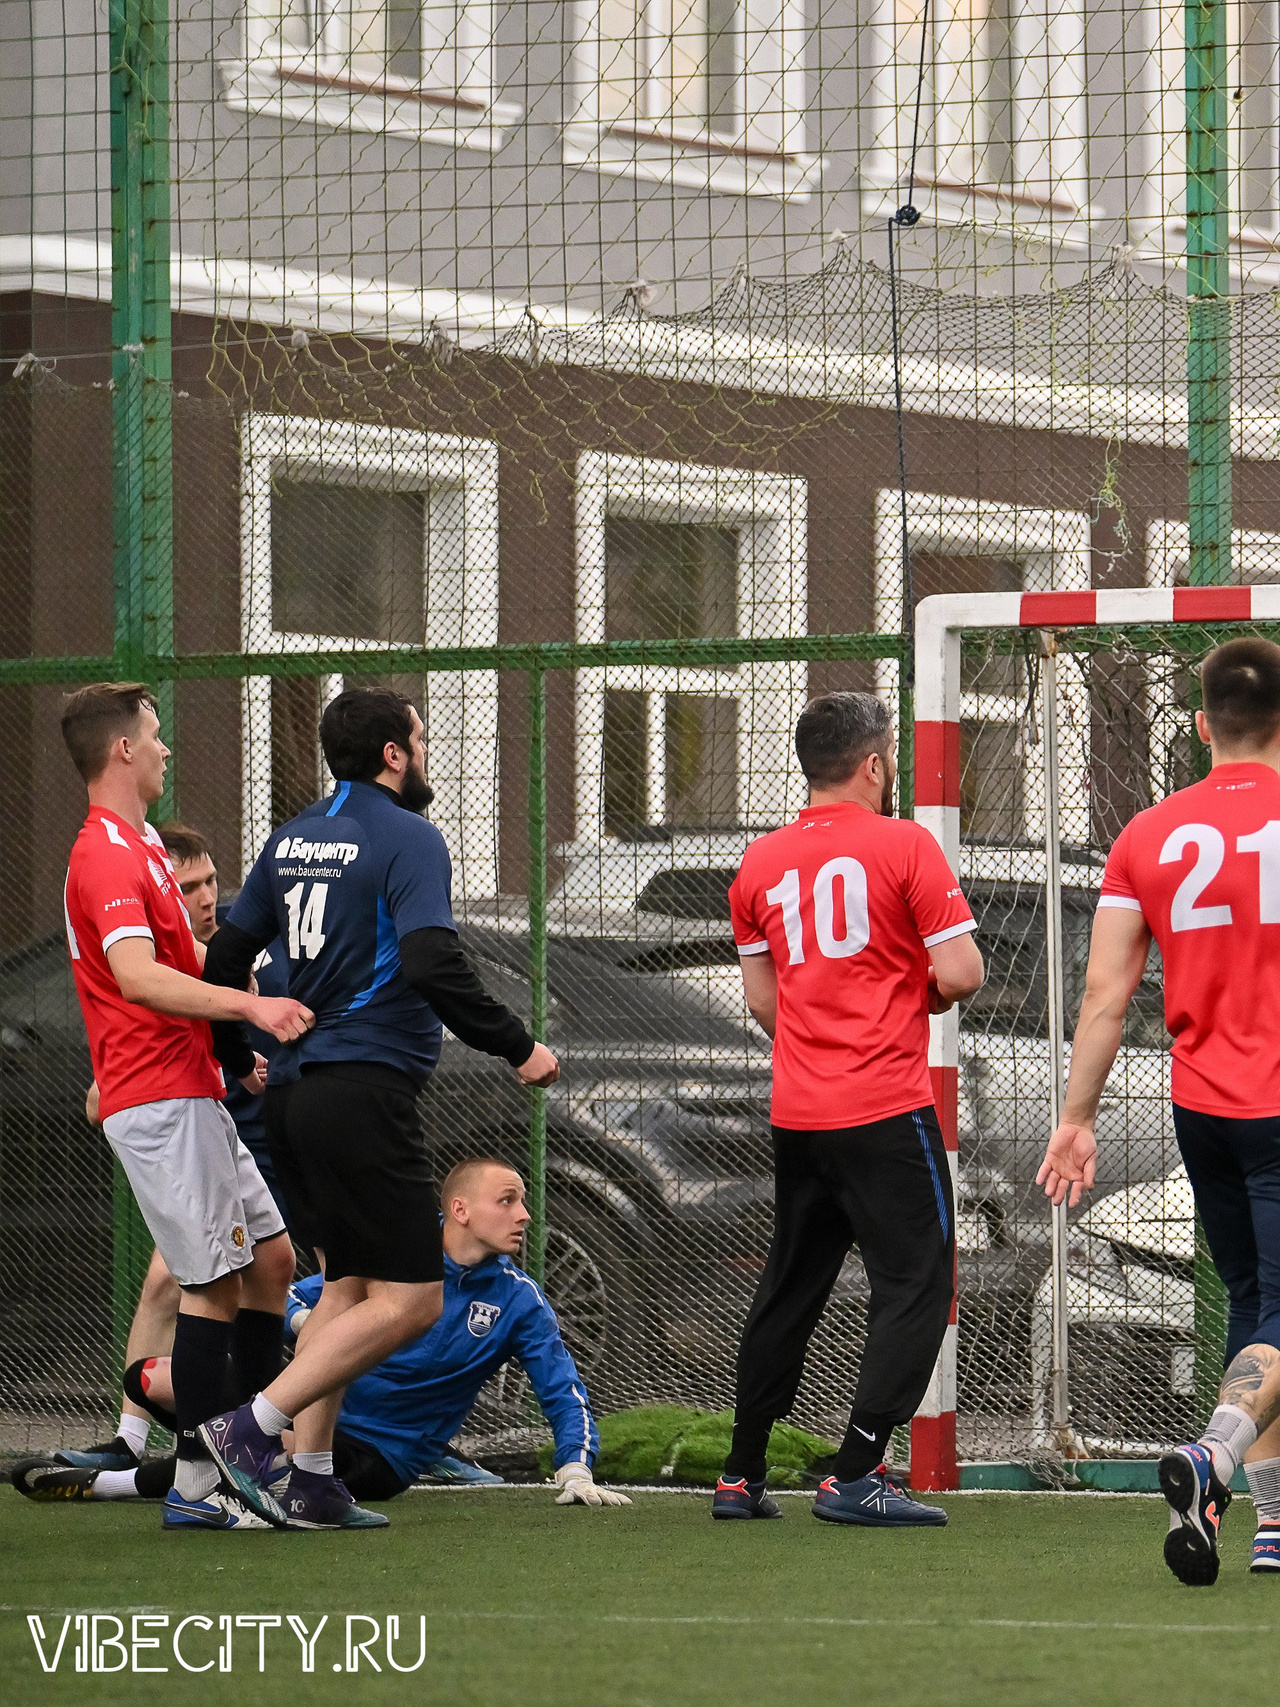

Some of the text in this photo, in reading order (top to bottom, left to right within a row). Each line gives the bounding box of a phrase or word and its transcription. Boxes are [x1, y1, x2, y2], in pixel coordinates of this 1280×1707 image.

[289, 837, 359, 865] Бауцентр
[278, 864, 342, 878] www.baucenter.ru
[284, 882, 329, 960] 14
[766, 856, 870, 966] 10
[290, 1498, 305, 1513] 10
